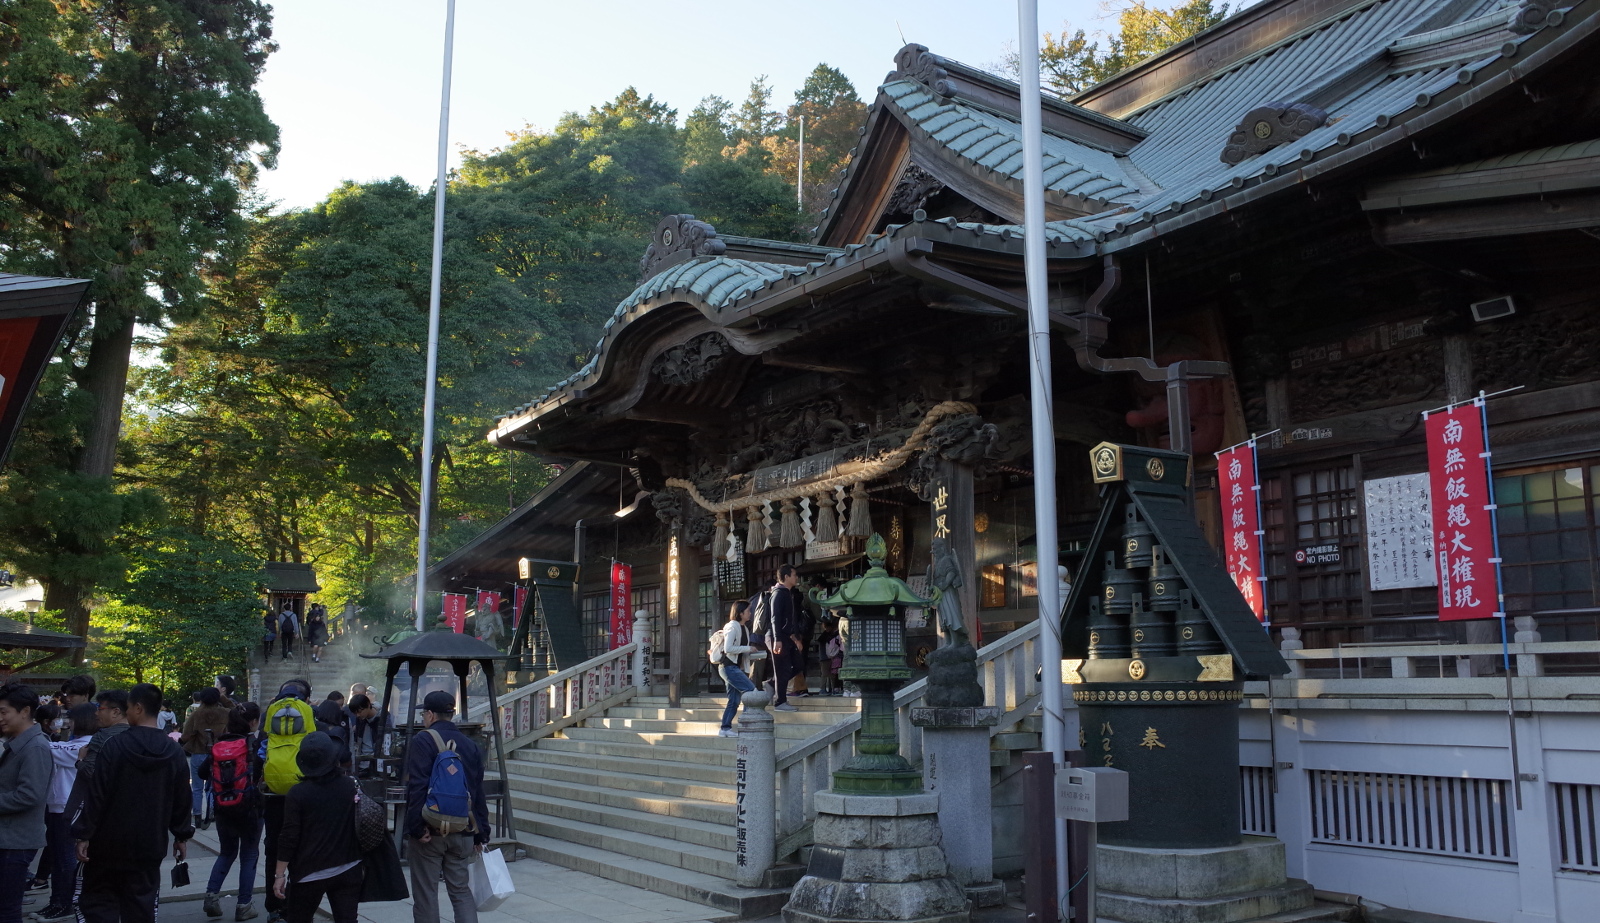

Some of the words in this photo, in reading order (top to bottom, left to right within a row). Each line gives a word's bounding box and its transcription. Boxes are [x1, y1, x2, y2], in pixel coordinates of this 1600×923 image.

[932, 487, 951, 539] 世界
[1418, 487, 1433, 562] 高尾山行事
[1442, 418, 1481, 609] 南無飯縄大権現
[1306, 544, 1339, 554] 堂内撮影禁止
[1306, 556, 1316, 564] NO
[1318, 553, 1340, 563] PHOTO
[616, 569, 626, 648] 南無飯縄大権
[641, 646, 651, 687] 相馬和夫
[571, 680, 579, 710] ヤクルト
[504, 707, 513, 739] ヤクルト
[521, 700, 529, 731] ヤクルト
[1138, 726, 1166, 751] 奉
[736, 758, 747, 867] 古河ヤクルト販売株
